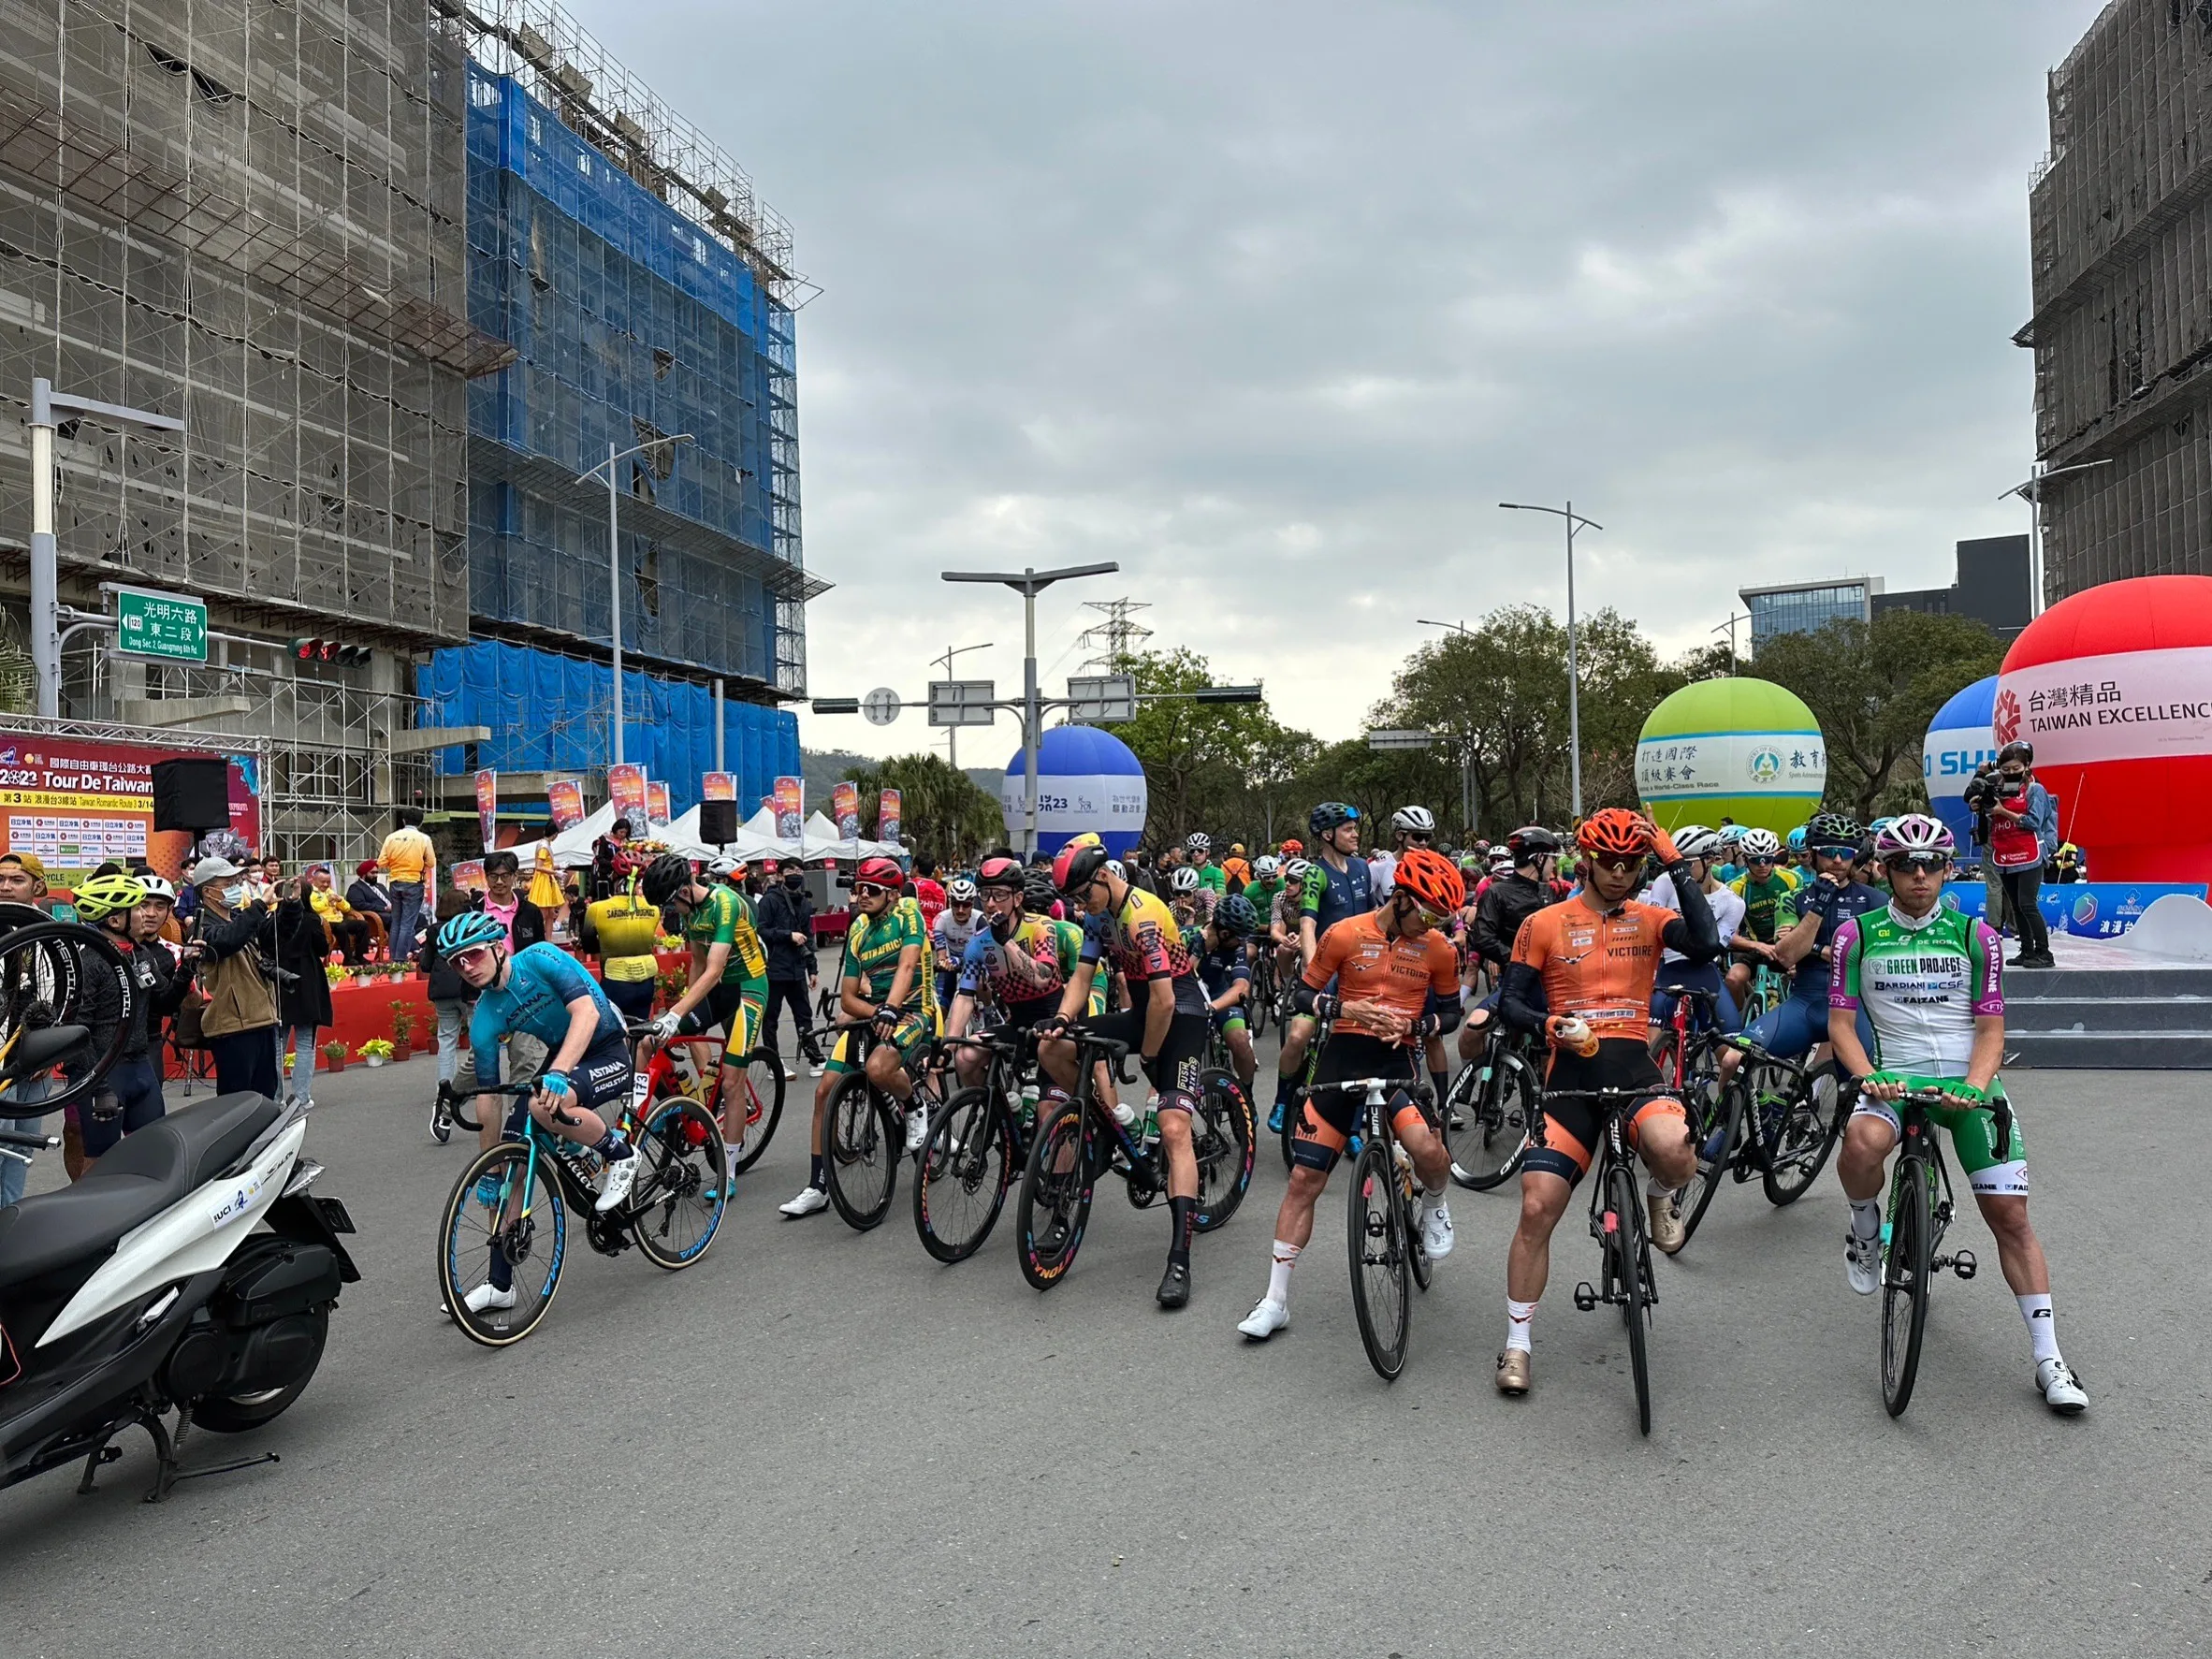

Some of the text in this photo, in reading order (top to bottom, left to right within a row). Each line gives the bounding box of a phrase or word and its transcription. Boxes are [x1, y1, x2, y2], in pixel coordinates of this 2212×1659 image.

[143, 602, 197, 625] 光明六路
[150, 622, 192, 642] 東二段
[129, 636, 141, 649] Dong
[2028, 680, 2121, 712] 台灣精品
[2030, 702, 2212, 733] TAIWAN EXCELLENC
[1641, 746, 1698, 763] 打造國際
[43, 771, 80, 790] Tour
[80, 774, 101, 791] De
[103, 776, 153, 793] Taiwan
[1053, 798, 1068, 808] 23
[919, 900, 944, 910] PHOTO
[1607, 945, 1653, 957] VICTOIRE
[1390, 964, 1429, 980] VICTOIRE
[1886, 957, 1960, 974] GREEN PROJECT
[1874, 981, 1925, 991] BARDIANI
[1938, 980, 1963, 989] CSF
[506, 992, 550, 1026] ASTANA
[1903, 995, 1949, 1004] FAIZANE
[589, 1061, 626, 1081] ASTANA
[1180, 1063, 1189, 1088] PUSH
[1188, 1059, 1198, 1092] BIKERS
[636, 1074, 648, 1097] 173
[1371, 1106, 1380, 1136] BMC
[1750, 1088, 1764, 1147] ARGON 18
[1609, 1118, 1623, 1157] BMC
[654, 1189, 676, 1206] ASTANA
[217, 1205, 232, 1220] UCI
[678, 1199, 723, 1259] CORIMA
[542, 1197, 564, 1296] CORIMA
